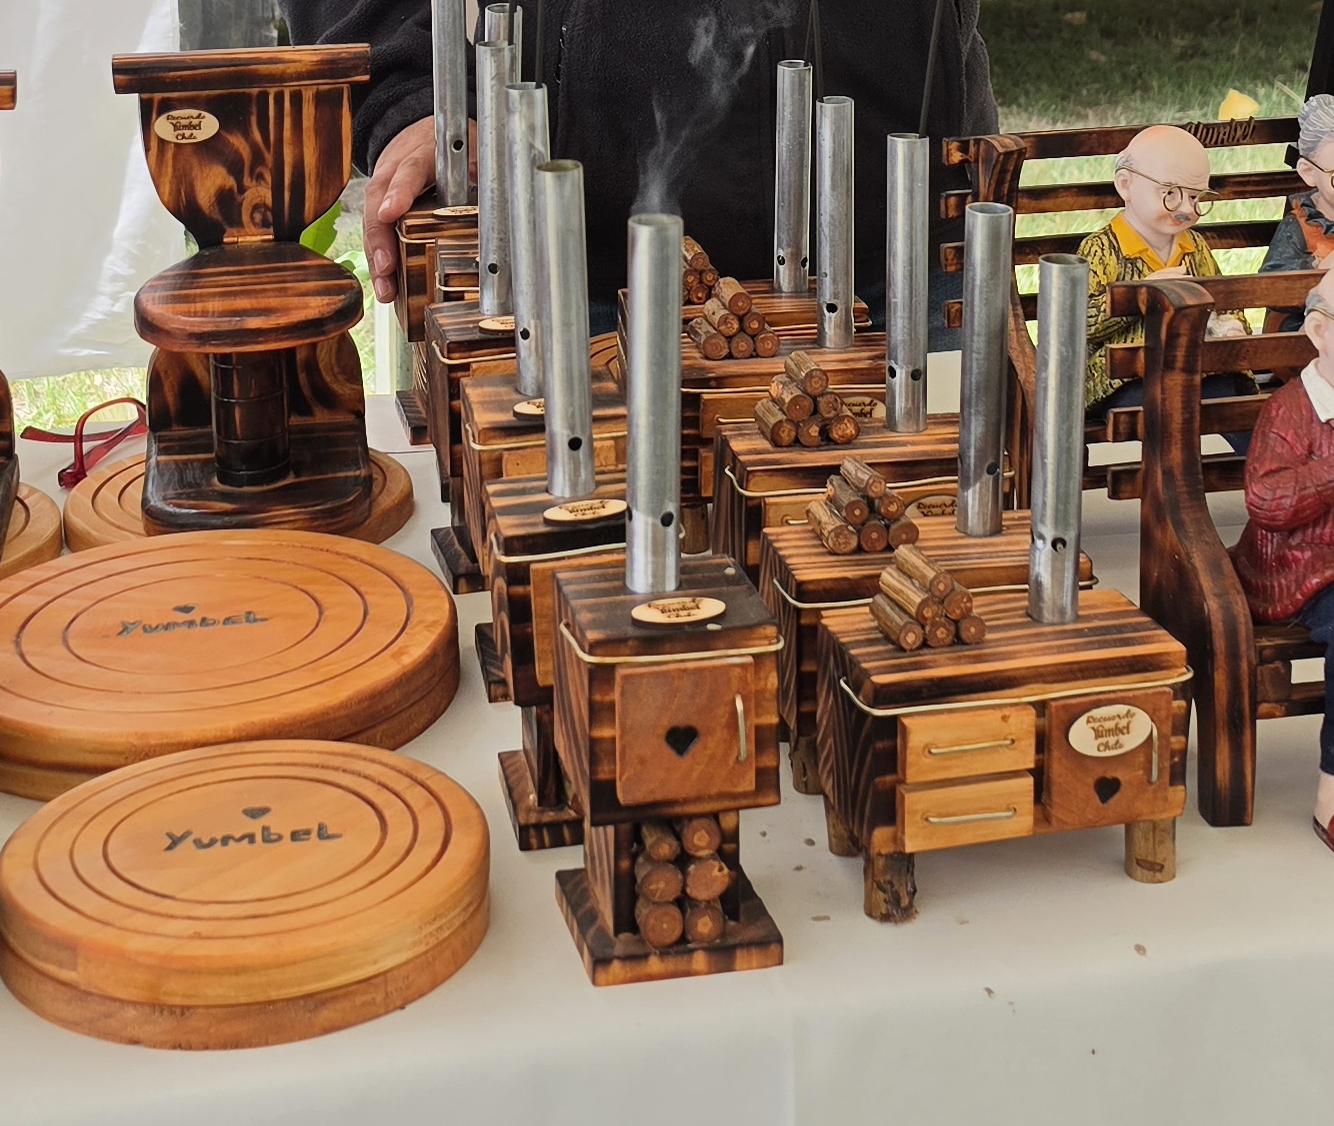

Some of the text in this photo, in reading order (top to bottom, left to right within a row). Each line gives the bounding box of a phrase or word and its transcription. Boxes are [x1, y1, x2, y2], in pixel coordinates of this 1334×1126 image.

[175, 132, 198, 140] Chile
[1086, 709, 1136, 725] Recuerdo
[1091, 721, 1132, 741] Yumbel
[1097, 739, 1125, 752] Chile
